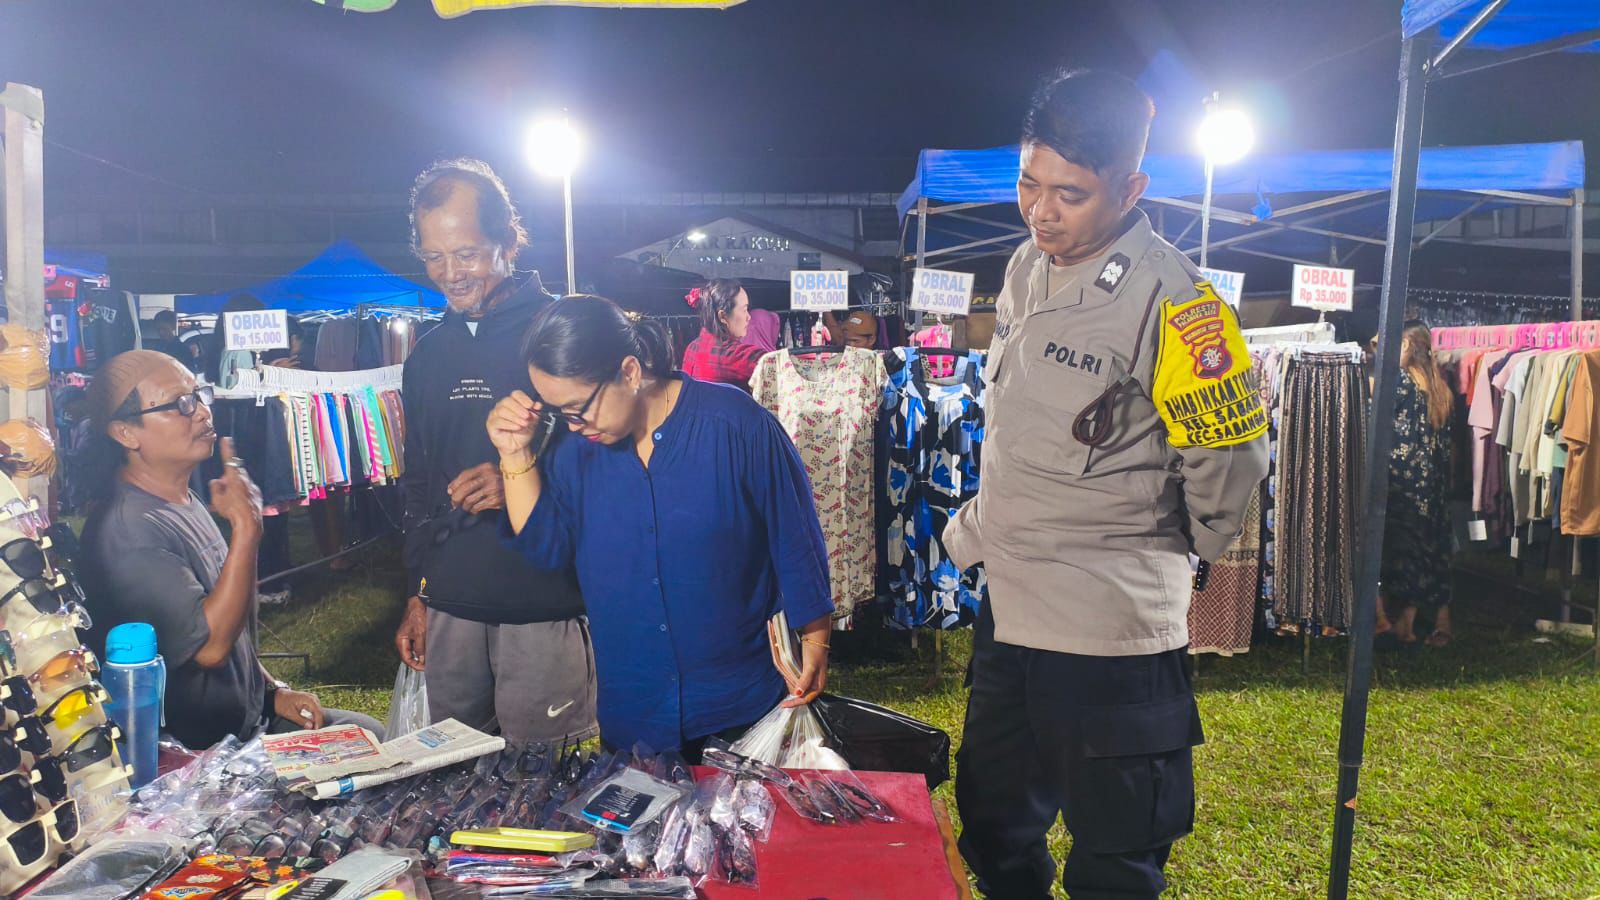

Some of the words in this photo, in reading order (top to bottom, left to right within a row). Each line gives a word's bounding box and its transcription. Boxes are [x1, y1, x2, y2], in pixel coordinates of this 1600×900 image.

[793, 272, 847, 290] OBRAL
[920, 271, 966, 293] OBRAL
[1300, 267, 1348, 289] OBRAL
[793, 291, 808, 308] Rp
[810, 290, 845, 305] 35.000
[917, 291, 931, 308] Rp
[932, 292, 965, 308] 35.000
[1299, 287, 1313, 304] Rp
[1315, 288, 1347, 304] 35.000
[231, 313, 281, 330] OBRAL
[1174, 303, 1217, 327] POLRESTA
[232, 333, 247, 348] Rp
[248, 331, 282, 345] 15.000
[1043, 341, 1103, 376] POLRI
